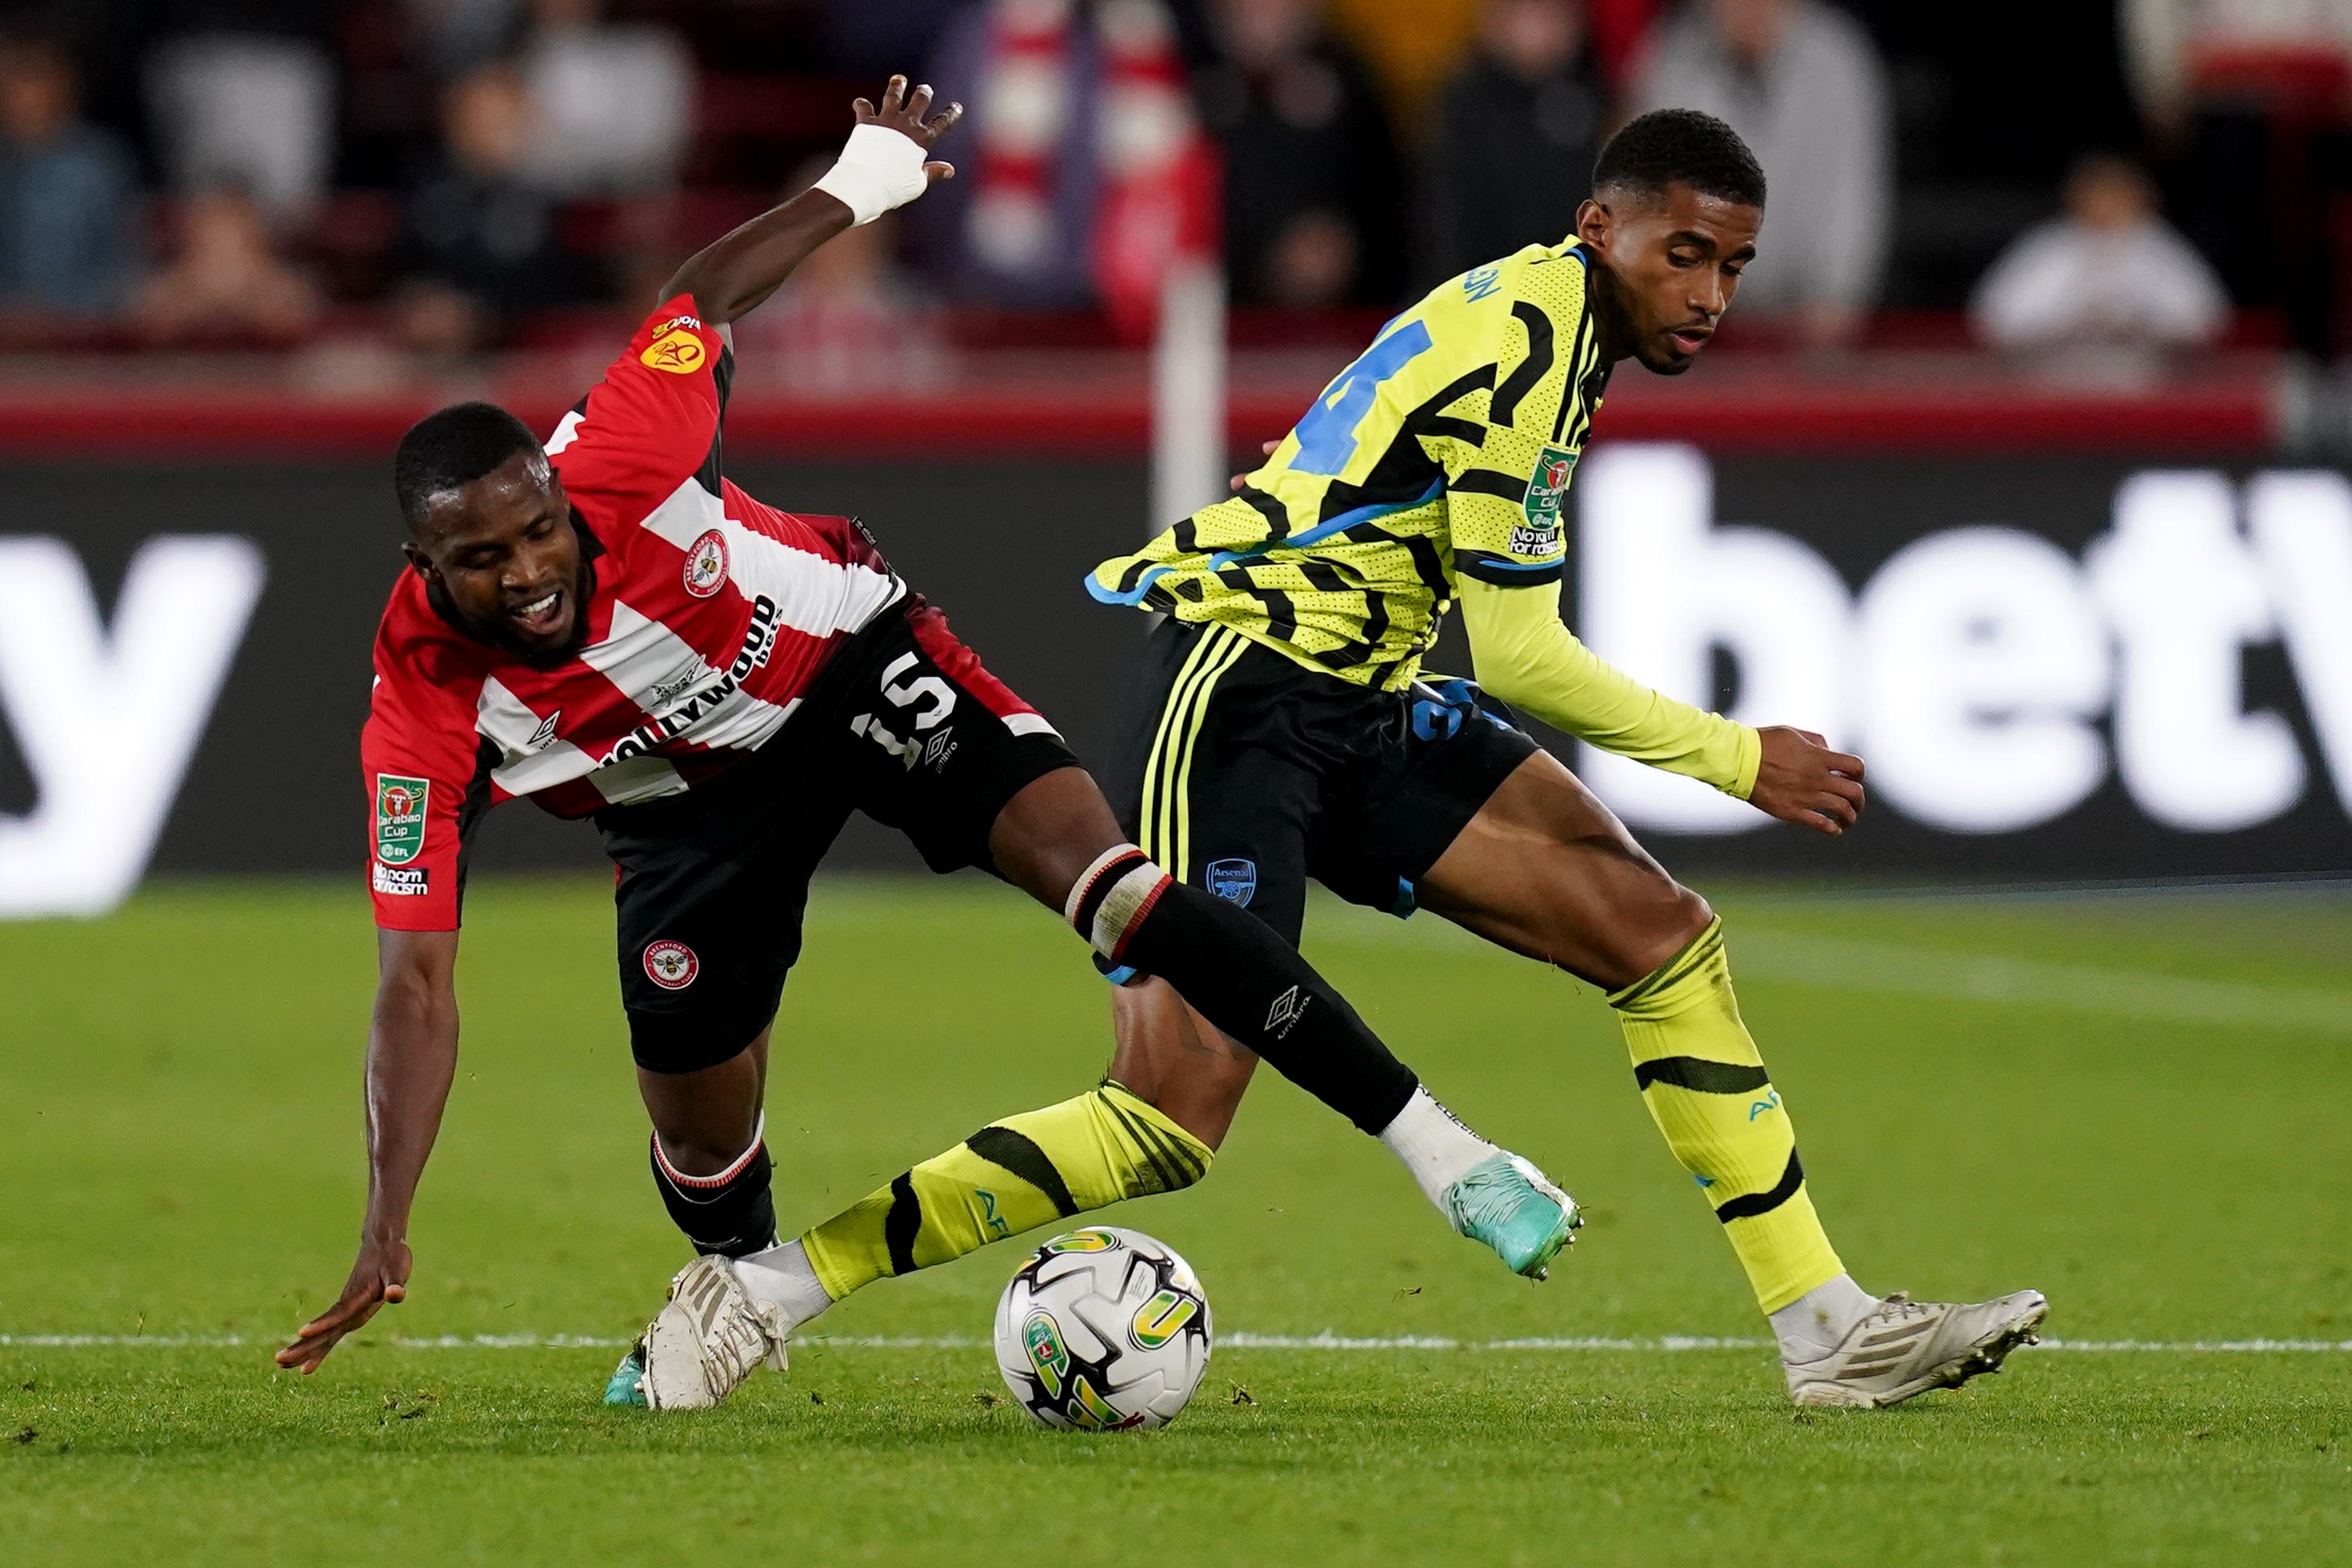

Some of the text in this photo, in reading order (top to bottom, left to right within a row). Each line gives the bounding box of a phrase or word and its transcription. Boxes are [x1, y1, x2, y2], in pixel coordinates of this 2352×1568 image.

[1287, 310, 1433, 476] 4
[1512, 526, 1535, 542] No
[755, 608, 784, 665] bets
[850, 650, 958, 772] 15
[934, 742, 959, 775] umbro
[385, 826, 408, 837] Cup
[394, 848, 409, 857] EFL
[1214, 868, 1249, 877] Arsenal
[649, 943, 687, 956] BRENTFORD
